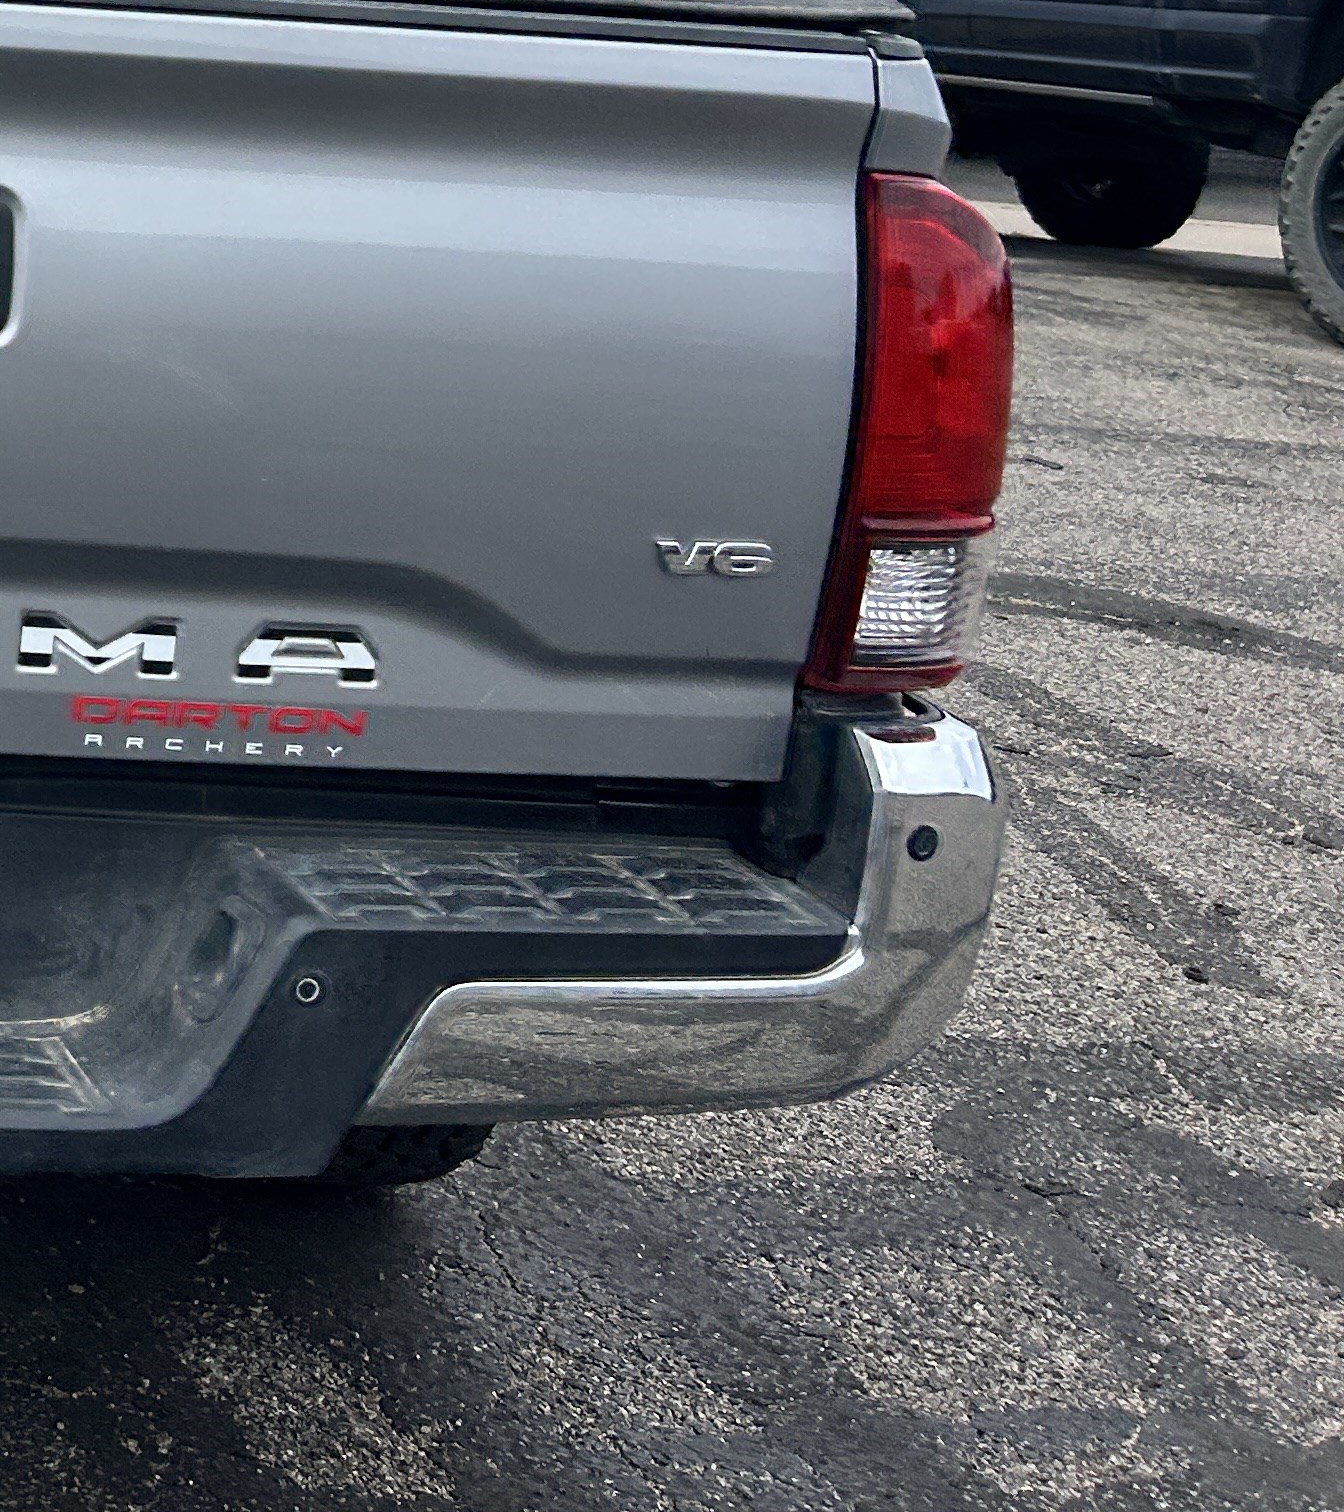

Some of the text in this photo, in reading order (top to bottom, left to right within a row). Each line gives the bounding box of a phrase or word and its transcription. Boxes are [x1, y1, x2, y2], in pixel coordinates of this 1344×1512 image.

[655, 539, 773, 577] V6
[69, 694, 370, 736] DARTON
[83, 733, 344, 758] ARCHERY
